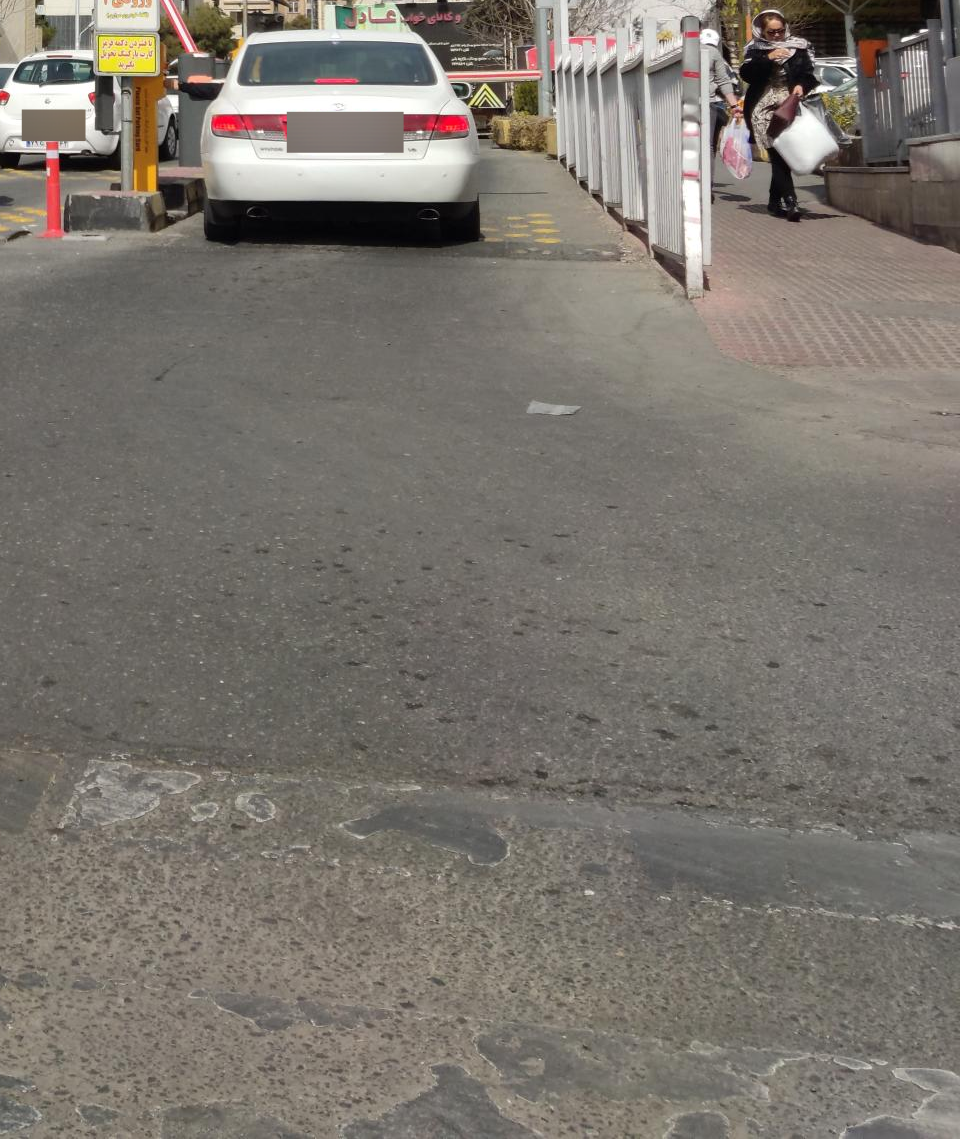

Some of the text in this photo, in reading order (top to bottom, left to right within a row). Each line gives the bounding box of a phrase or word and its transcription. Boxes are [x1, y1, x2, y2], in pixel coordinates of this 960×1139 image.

[345, 6, 396, 28] عادل
[427, 12, 454, 25] کالای
[455, 15, 462, 24] و
